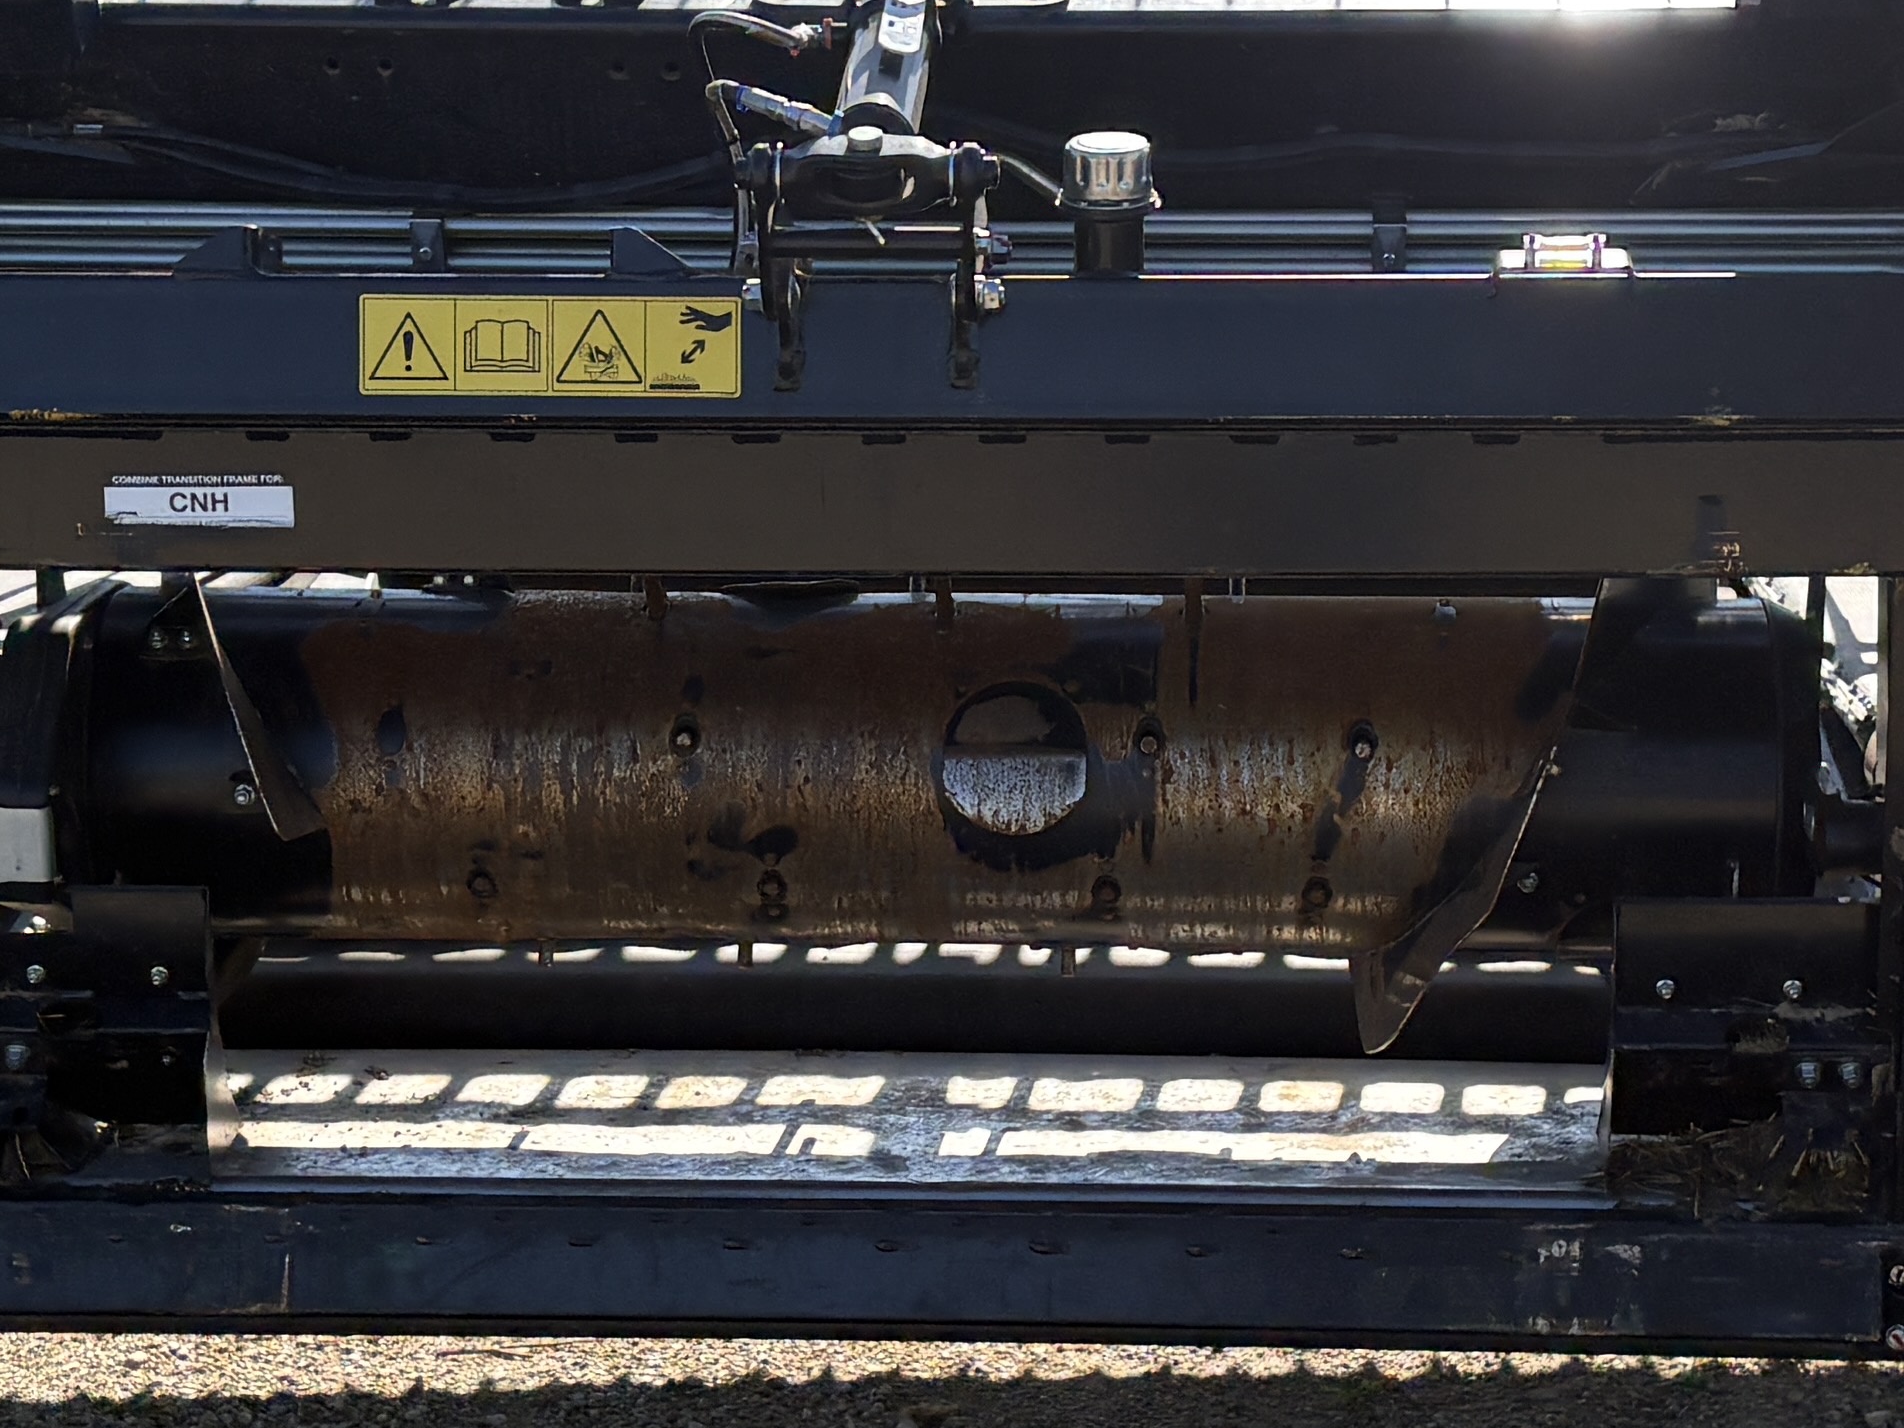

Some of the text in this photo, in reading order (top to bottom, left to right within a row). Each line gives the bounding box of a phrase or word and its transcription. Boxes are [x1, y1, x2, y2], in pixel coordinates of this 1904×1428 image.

[112, 475, 160, 484] COMBINE
[162, 475, 221, 484] TRANSITION
[223, 475, 258, 484] FRAME
[169, 492, 229, 513] CNH
